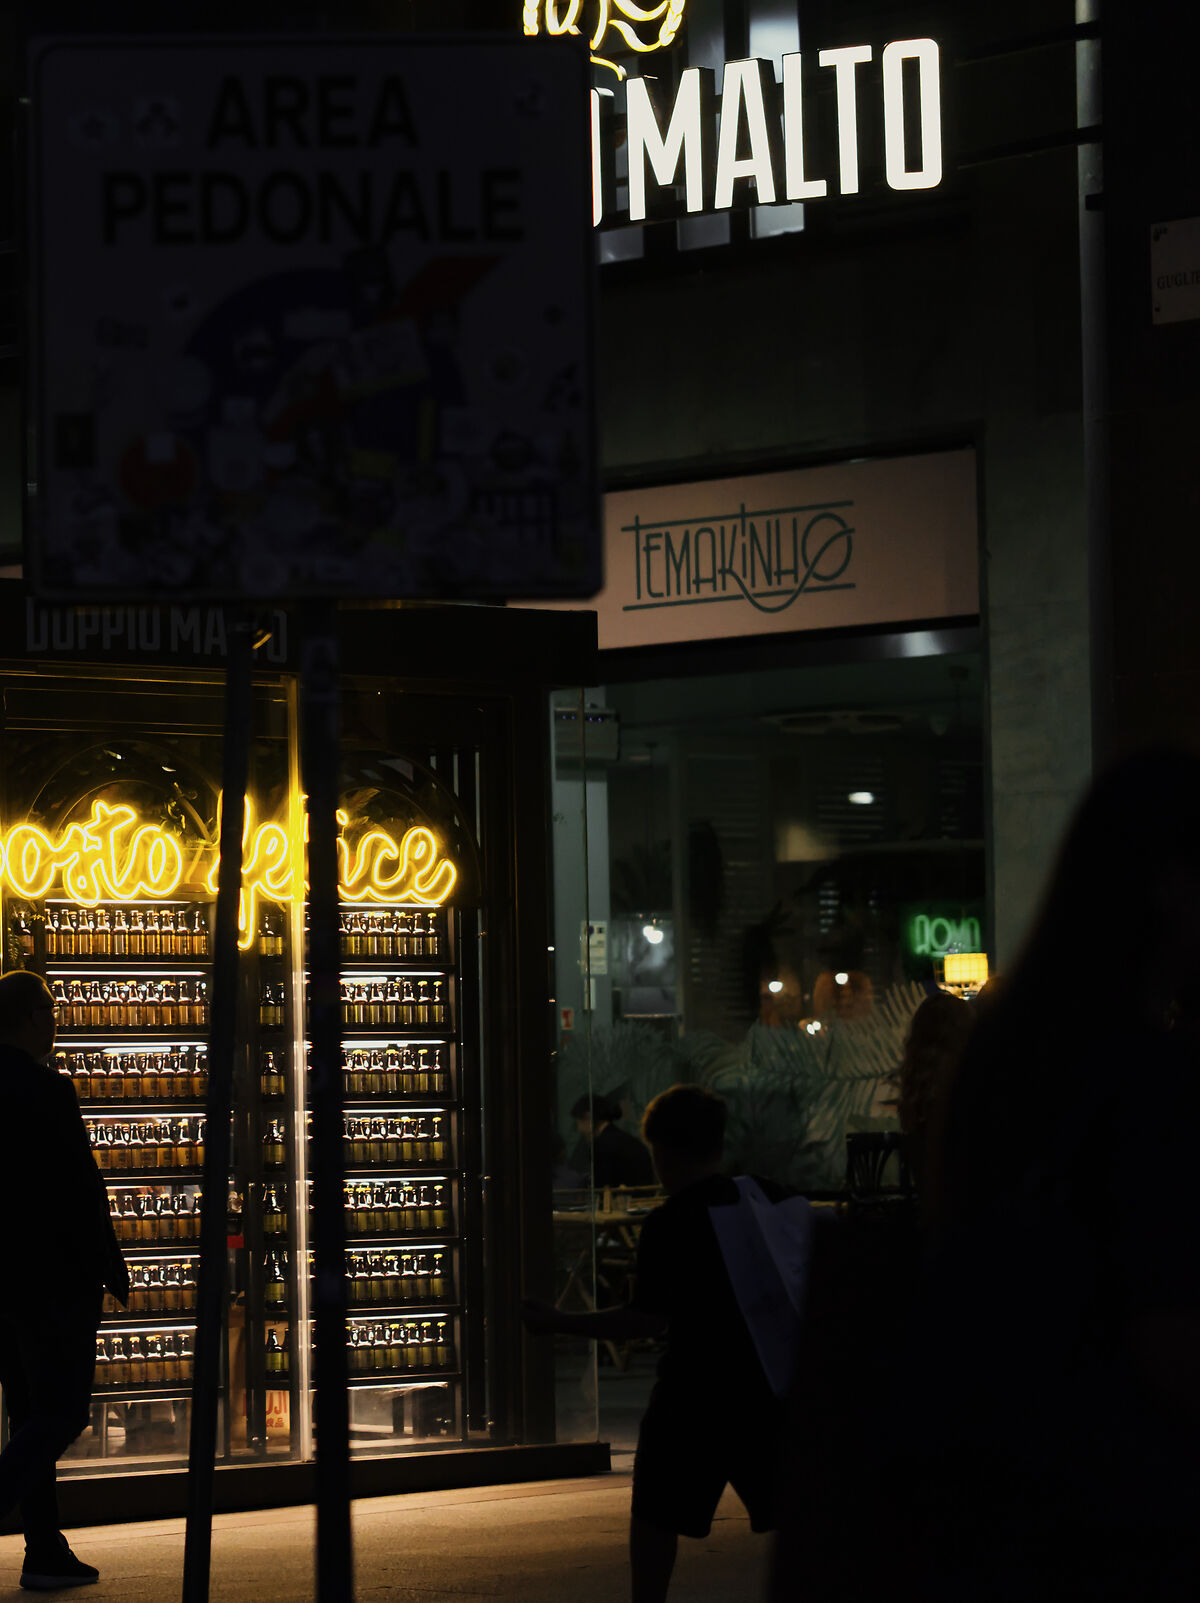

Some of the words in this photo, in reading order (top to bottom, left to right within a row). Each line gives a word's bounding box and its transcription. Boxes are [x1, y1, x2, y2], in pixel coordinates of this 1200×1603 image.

[207, 73, 420, 149] AREA
[625, 37, 943, 222] MALTO
[103, 168, 525, 246] PEDONALE
[169, 603, 289, 665] MAO
